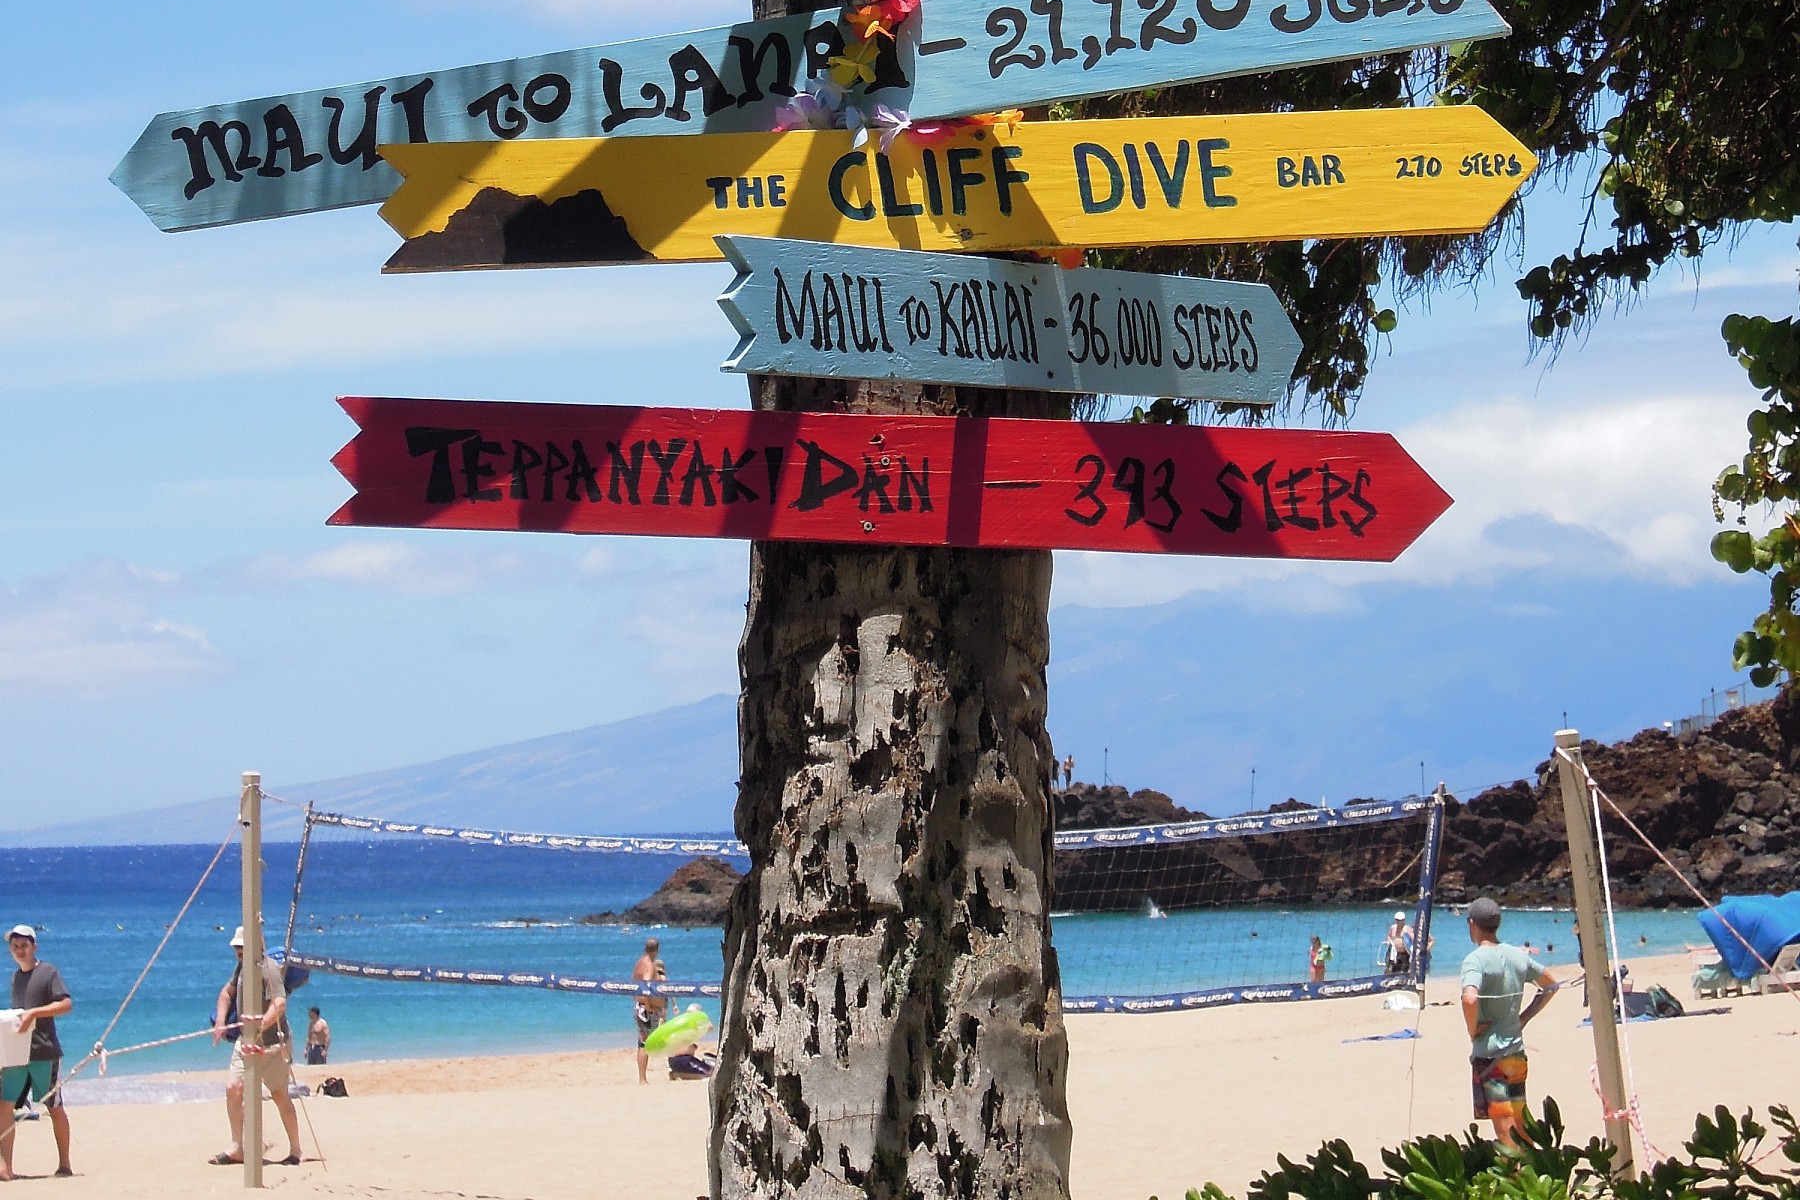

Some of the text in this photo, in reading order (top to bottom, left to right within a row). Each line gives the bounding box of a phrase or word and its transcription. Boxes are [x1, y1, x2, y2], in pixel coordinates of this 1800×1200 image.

[172, 77, 436, 201] MAUI
[468, 72, 572, 140] TO
[706, 138, 1522, 221] THE CLIFF DIVE BAR 270 STEPS
[774, 267, 894, 353] MAUI
[930, 279, 1039, 364] KAUAI
[1067, 292, 1161, 369] 36,000
[1172, 302, 1260, 374] STEPS
[404, 427, 785, 505] TEPPANYAKI
[788, 438, 934, 514] DAN
[1065, 455, 1184, 533] 393
[1201, 458, 1377, 537] STEPS
[1349, 806, 1393, 818] BUD LIGHT
[1294, 815, 1320, 824] LIGHT
[1238, 821, 1264, 830] LIGHT
[1184, 826, 1209, 835] LIGHT
[1117, 832, 1141, 840] LIGHT
[1323, 982, 1373, 994] BUD LIGHT
[1207, 993, 1234, 1002] LIGHT
[1265, 989, 1293, 998] LIGHT
[1150, 1000, 1175, 1008] LIGHT
